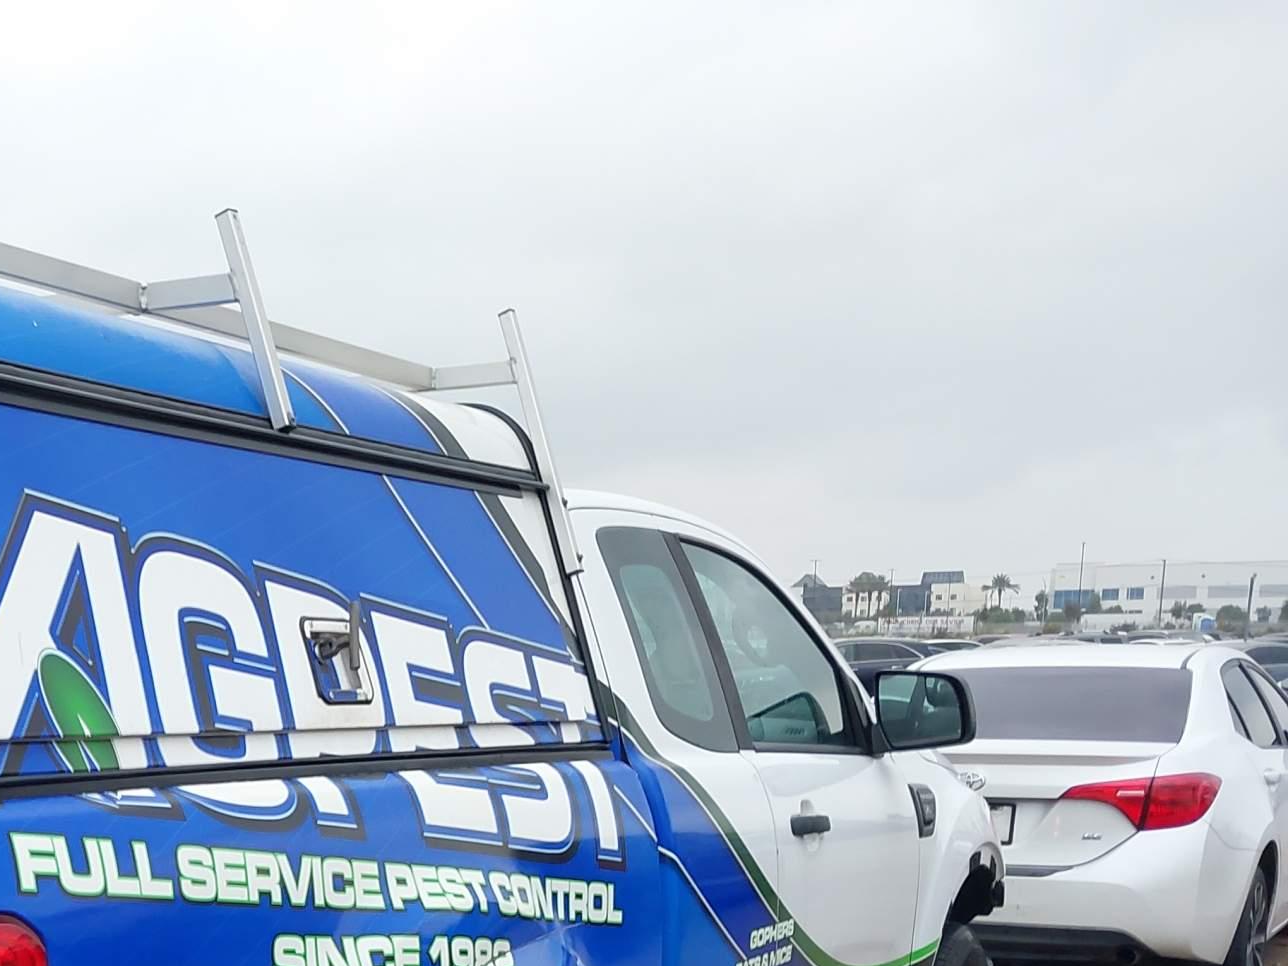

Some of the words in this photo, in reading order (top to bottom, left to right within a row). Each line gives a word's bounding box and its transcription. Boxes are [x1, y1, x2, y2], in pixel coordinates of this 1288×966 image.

[9, 831, 174, 901] FULL
[176, 843, 385, 911] SERVICE
[384, 863, 488, 912] PEST
[488, 871, 623, 924] CONTROL
[750, 919, 794, 950] GOPHERS
